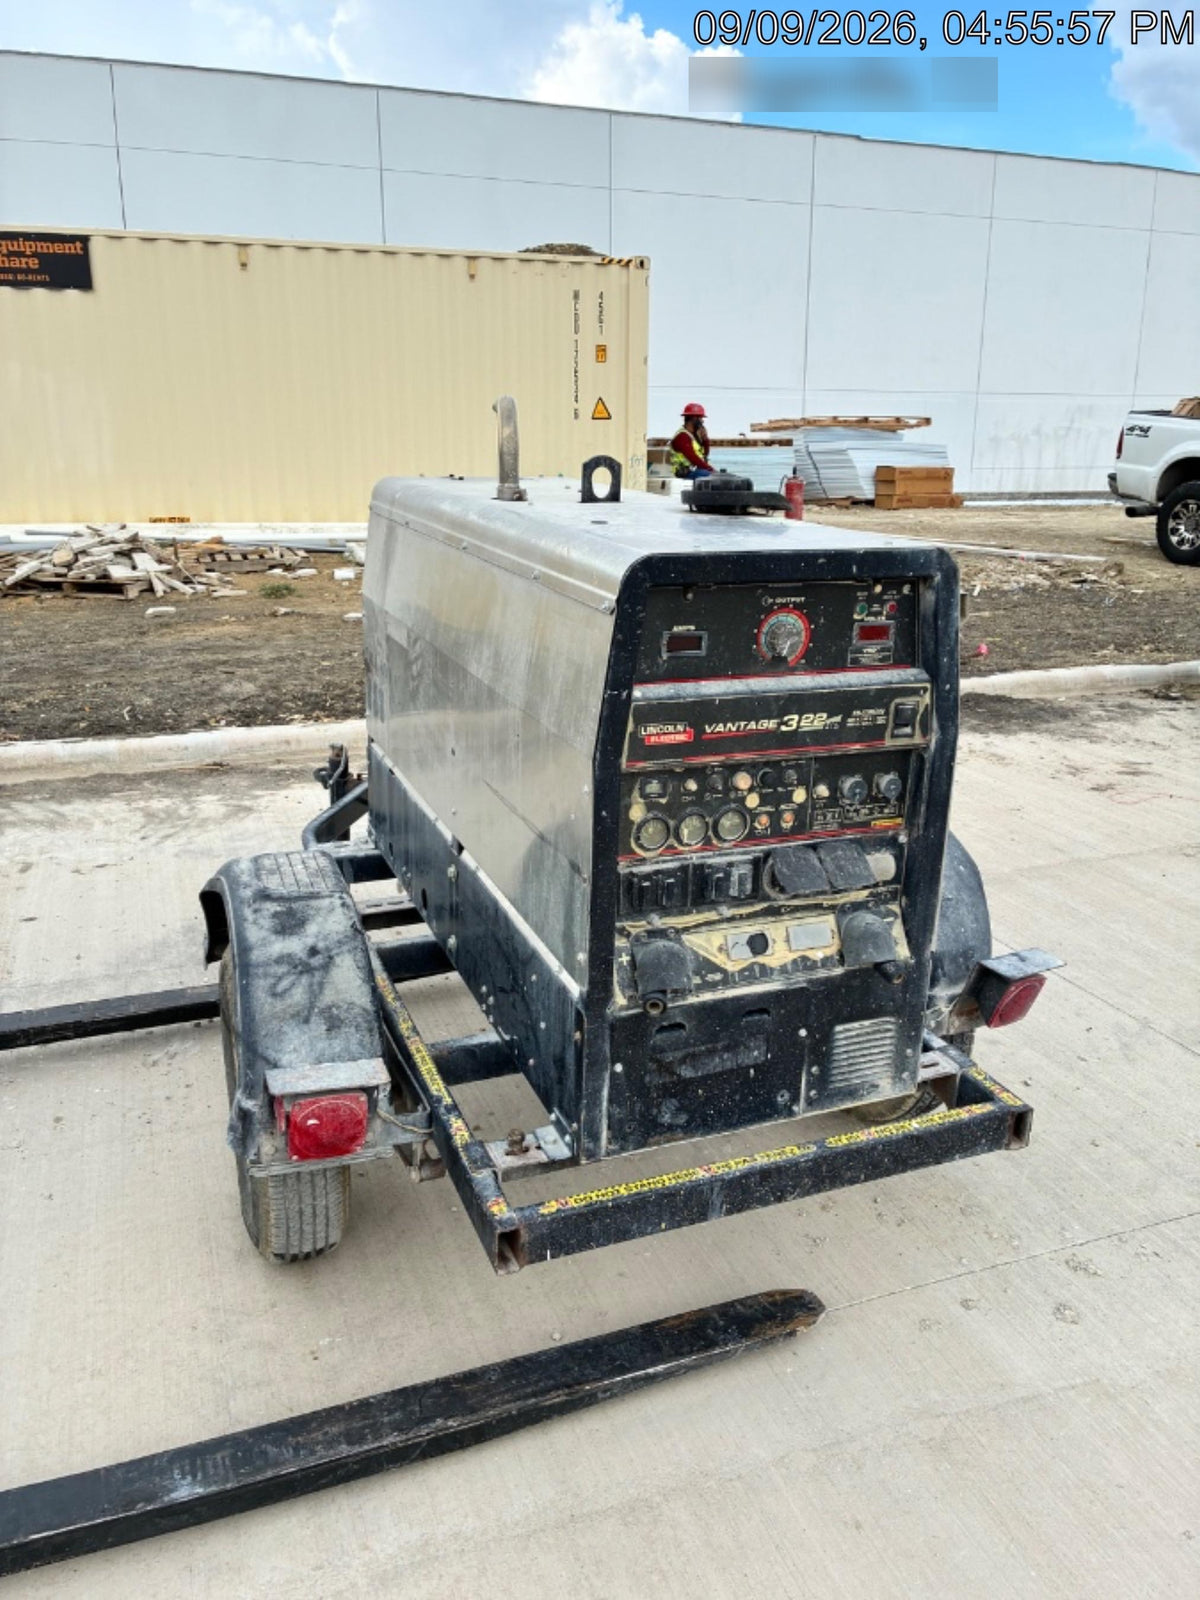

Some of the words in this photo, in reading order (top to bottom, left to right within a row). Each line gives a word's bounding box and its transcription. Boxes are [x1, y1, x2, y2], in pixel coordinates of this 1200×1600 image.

[640, 723, 686, 736] LINCOLN
[704, 718, 780, 733] VANTAGE
[780, 712, 829, 732] 322
